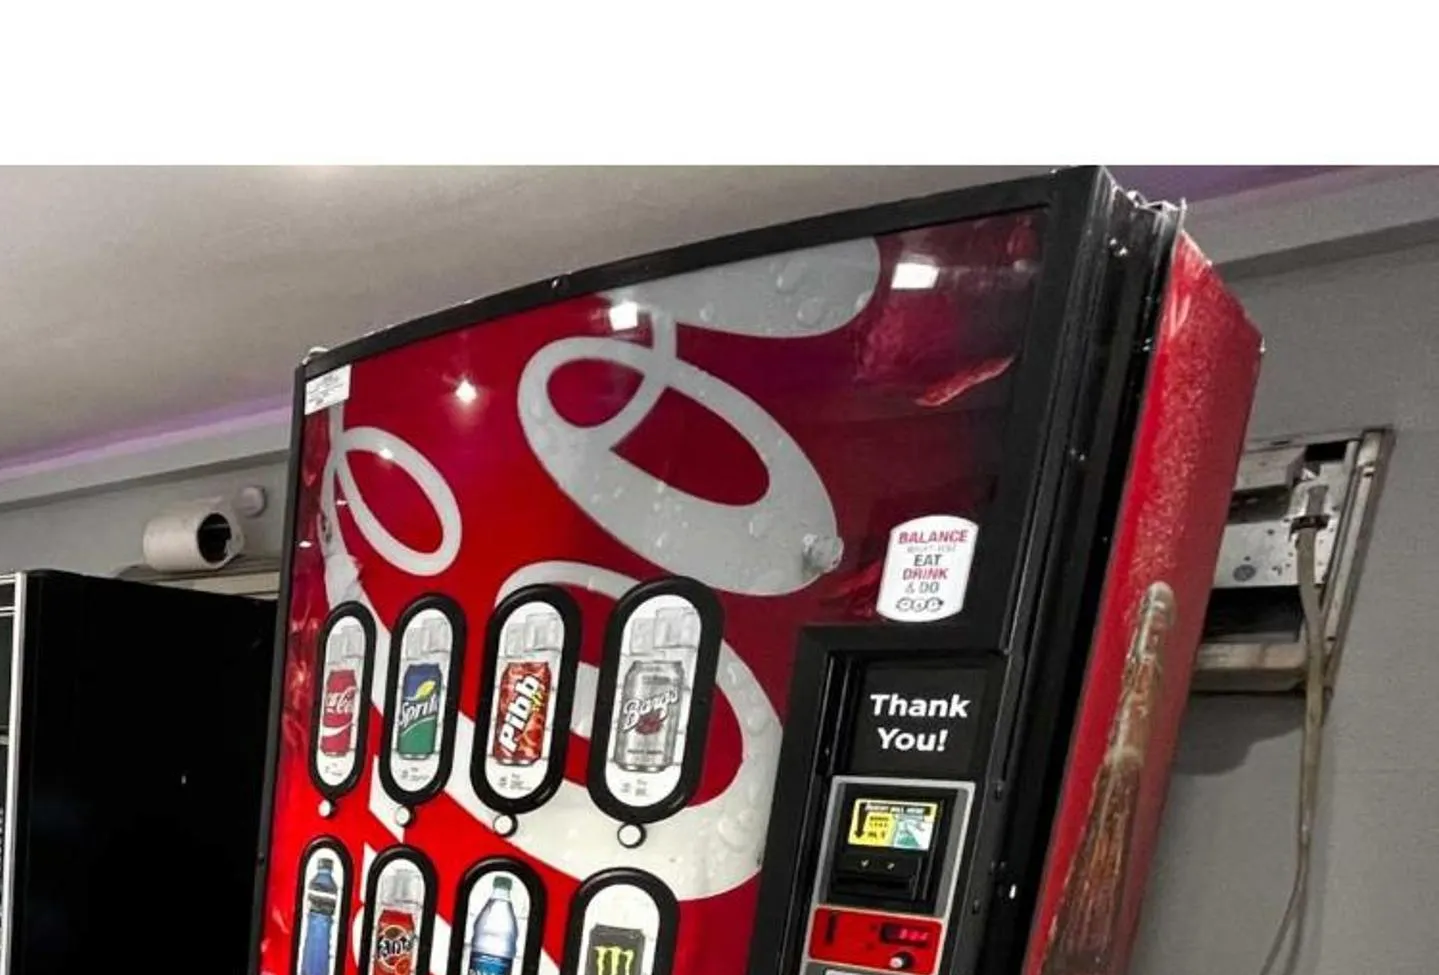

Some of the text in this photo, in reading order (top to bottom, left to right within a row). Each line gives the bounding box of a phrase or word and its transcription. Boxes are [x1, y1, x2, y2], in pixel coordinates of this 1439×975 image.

[898, 529, 969, 545] BALANCE
[913, 553, 942, 567] EAT
[902, 567, 949, 580] DRINK
[918, 581, 940, 594] DO
[498, 675, 540, 753] Pibb
[870, 694, 971, 719] Thank
[877, 727, 949, 752] You!
